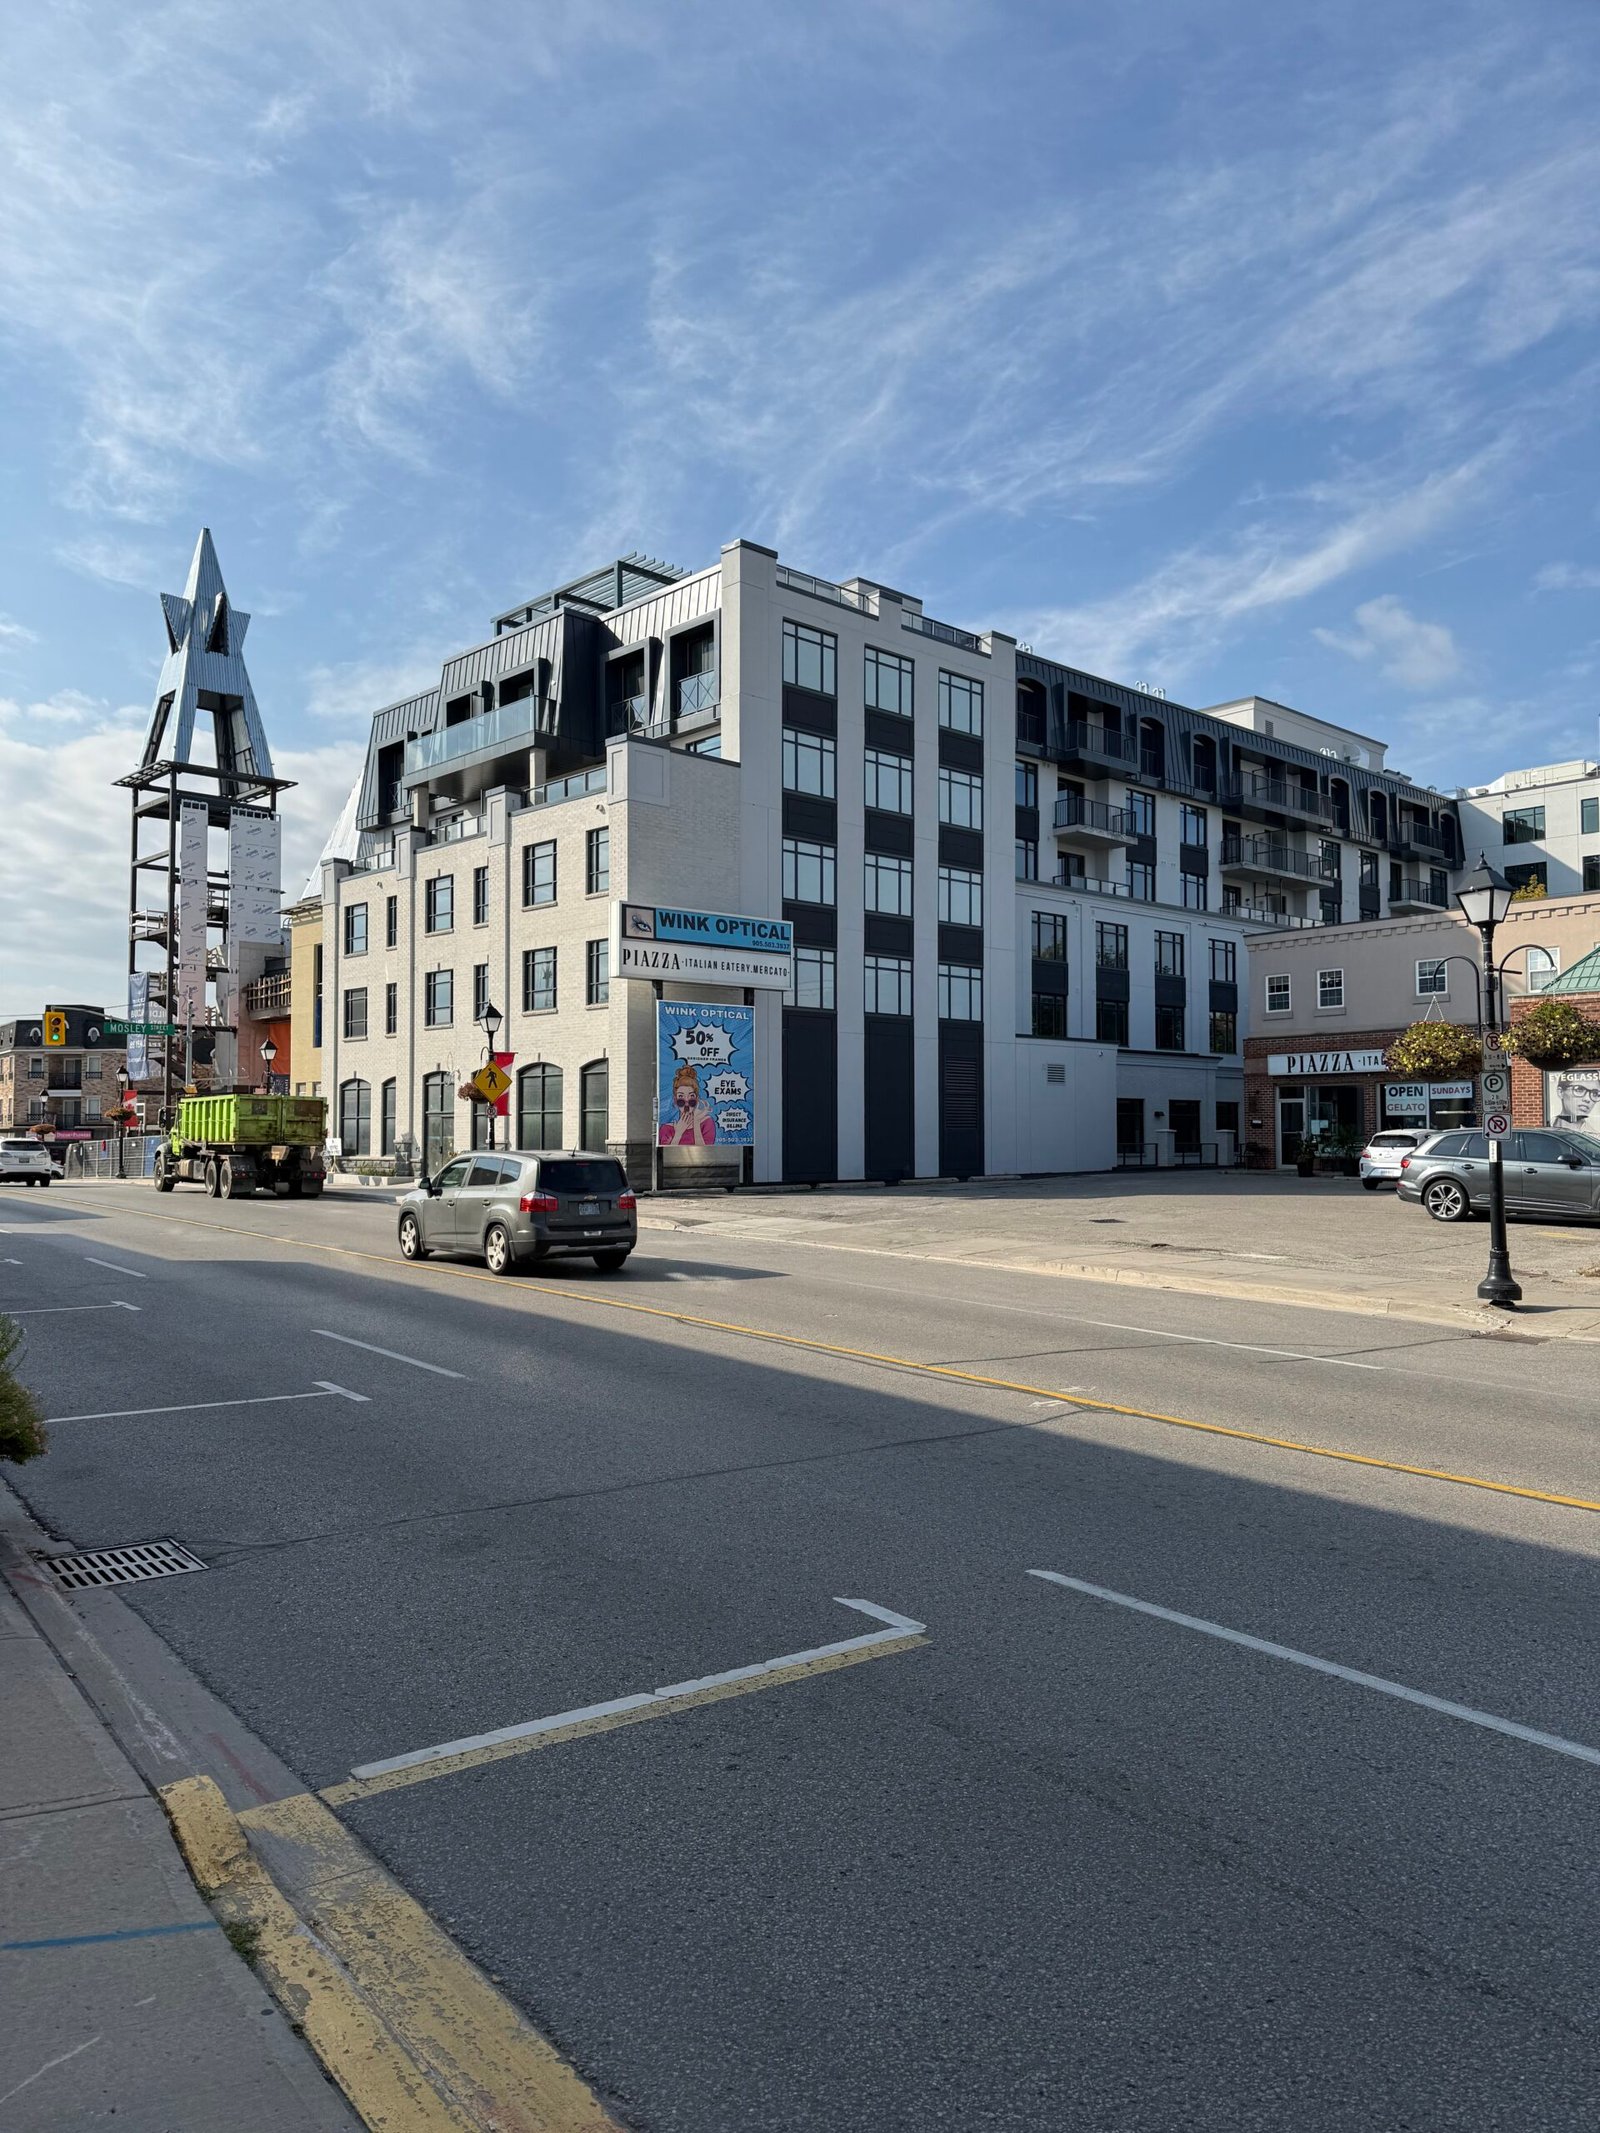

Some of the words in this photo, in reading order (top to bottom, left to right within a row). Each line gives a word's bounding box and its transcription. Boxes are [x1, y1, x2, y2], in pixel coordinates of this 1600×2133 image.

[658, 911, 710, 932] WINK
[715, 918, 790, 941] OPTICAL
[622, 948, 681, 970] PIAZZA
[664, 1006, 697, 1016] WINK
[701, 1009, 749, 1020] OPTICAL
[110, 1023, 146, 1033] MOSLEY
[685, 1030, 714, 1045] 50%
[700, 1047, 720, 1057] OFF
[1286, 1052, 1354, 1074] PIAZZA
[720, 1080, 736, 1088] EYE
[714, 1087, 742, 1095] EXAMS
[1388, 1086, 1424, 1097] OPEN
[1431, 1086, 1471, 1095] SUNDAYS
[1387, 1103, 1425, 1112] GELATO
